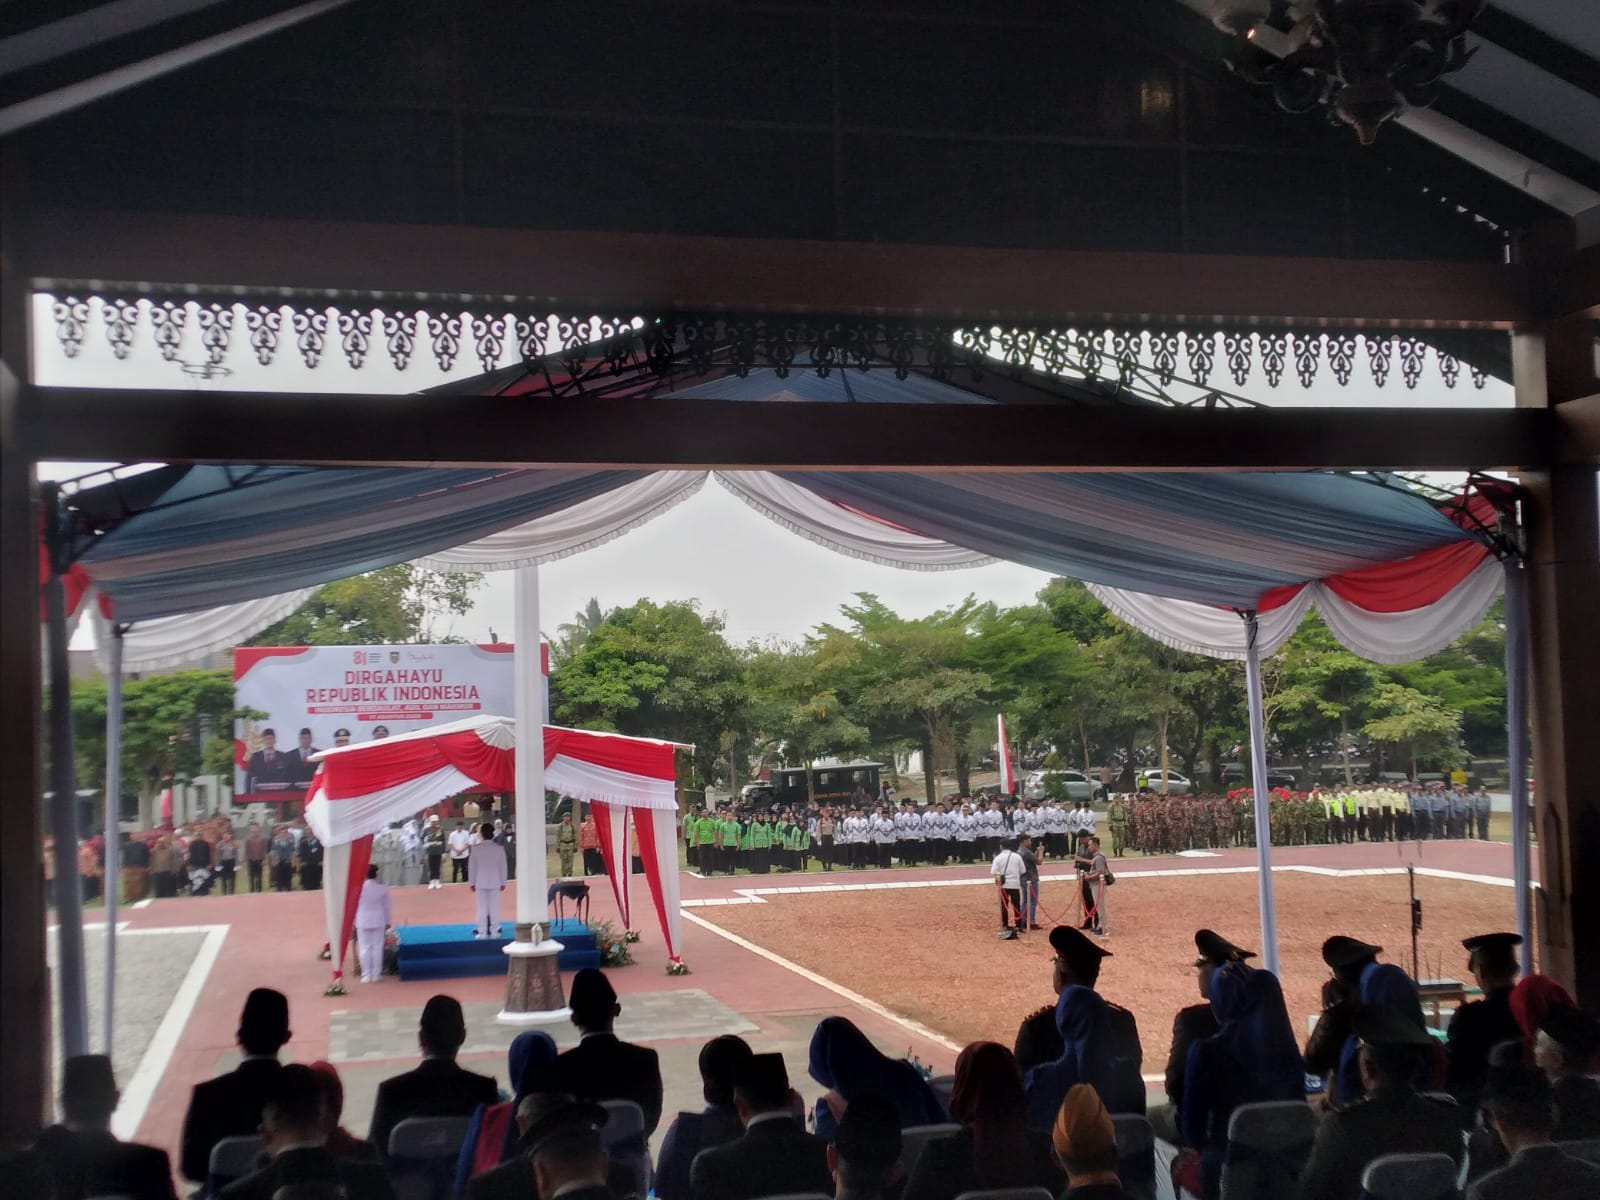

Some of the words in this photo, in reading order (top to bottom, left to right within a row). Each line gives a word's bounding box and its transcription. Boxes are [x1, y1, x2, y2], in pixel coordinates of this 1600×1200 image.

[345, 669, 443, 685] DIRGAHAYU
[306, 687, 387, 703] REPUBLIK
[393, 685, 480, 701] INDONESIA
